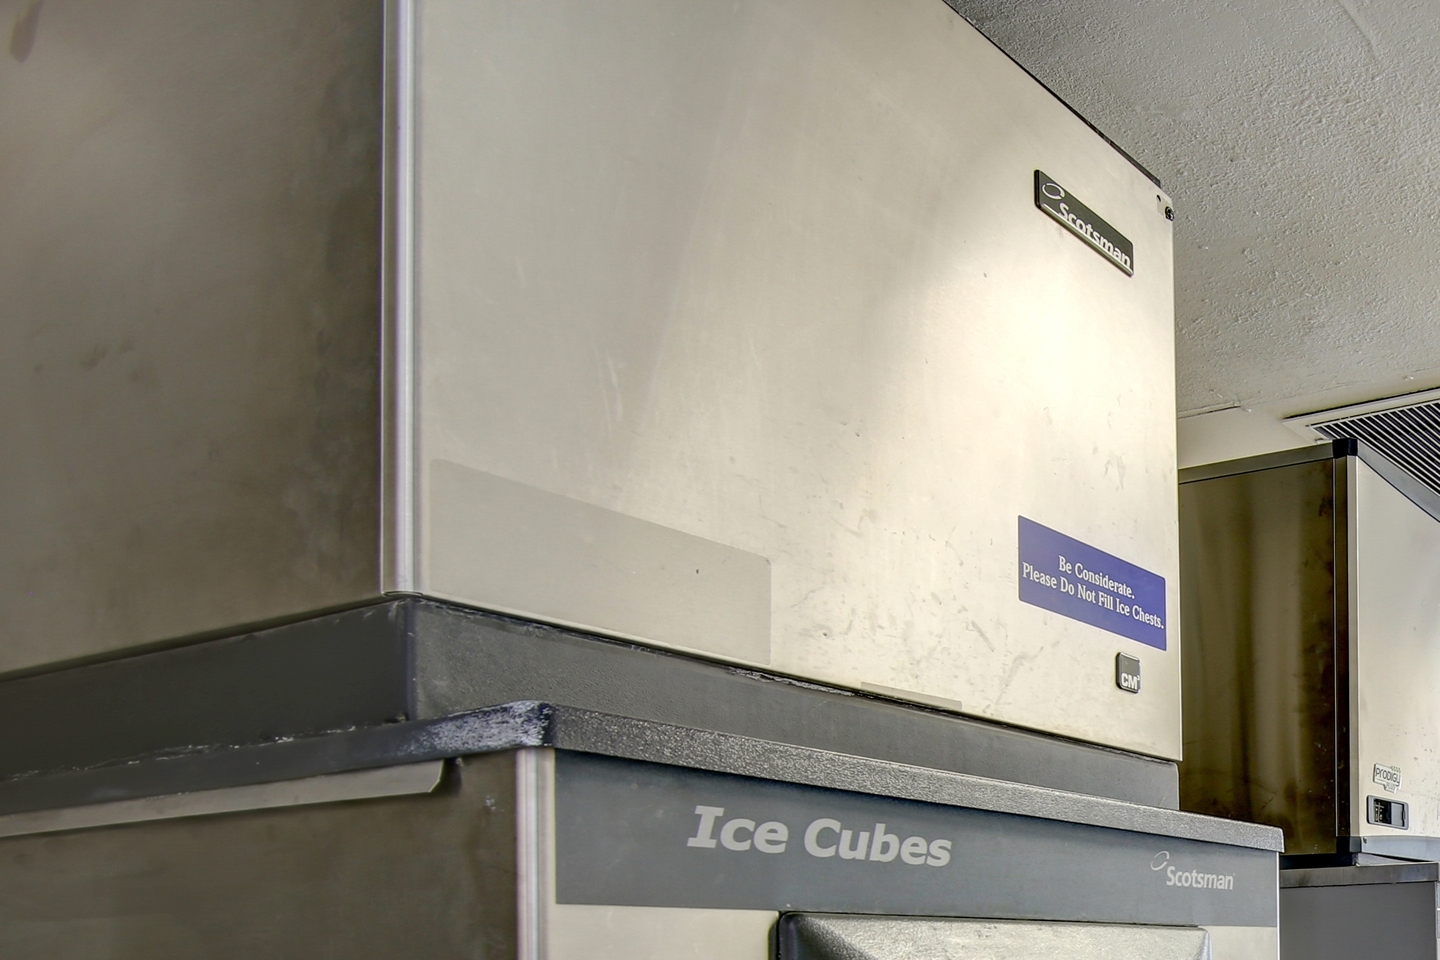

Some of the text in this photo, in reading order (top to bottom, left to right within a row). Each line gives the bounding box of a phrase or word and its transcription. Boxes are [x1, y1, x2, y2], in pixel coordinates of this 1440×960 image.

[1058, 202, 1131, 269] Scotsman
[1022, 561, 1164, 629] Please Do Not Fill Ice Chests.
[1058, 555, 1135, 599] Be Considerate.
[687, 805, 952, 867] Ice Cubes
[1166, 865, 1234, 890] Scotsman
